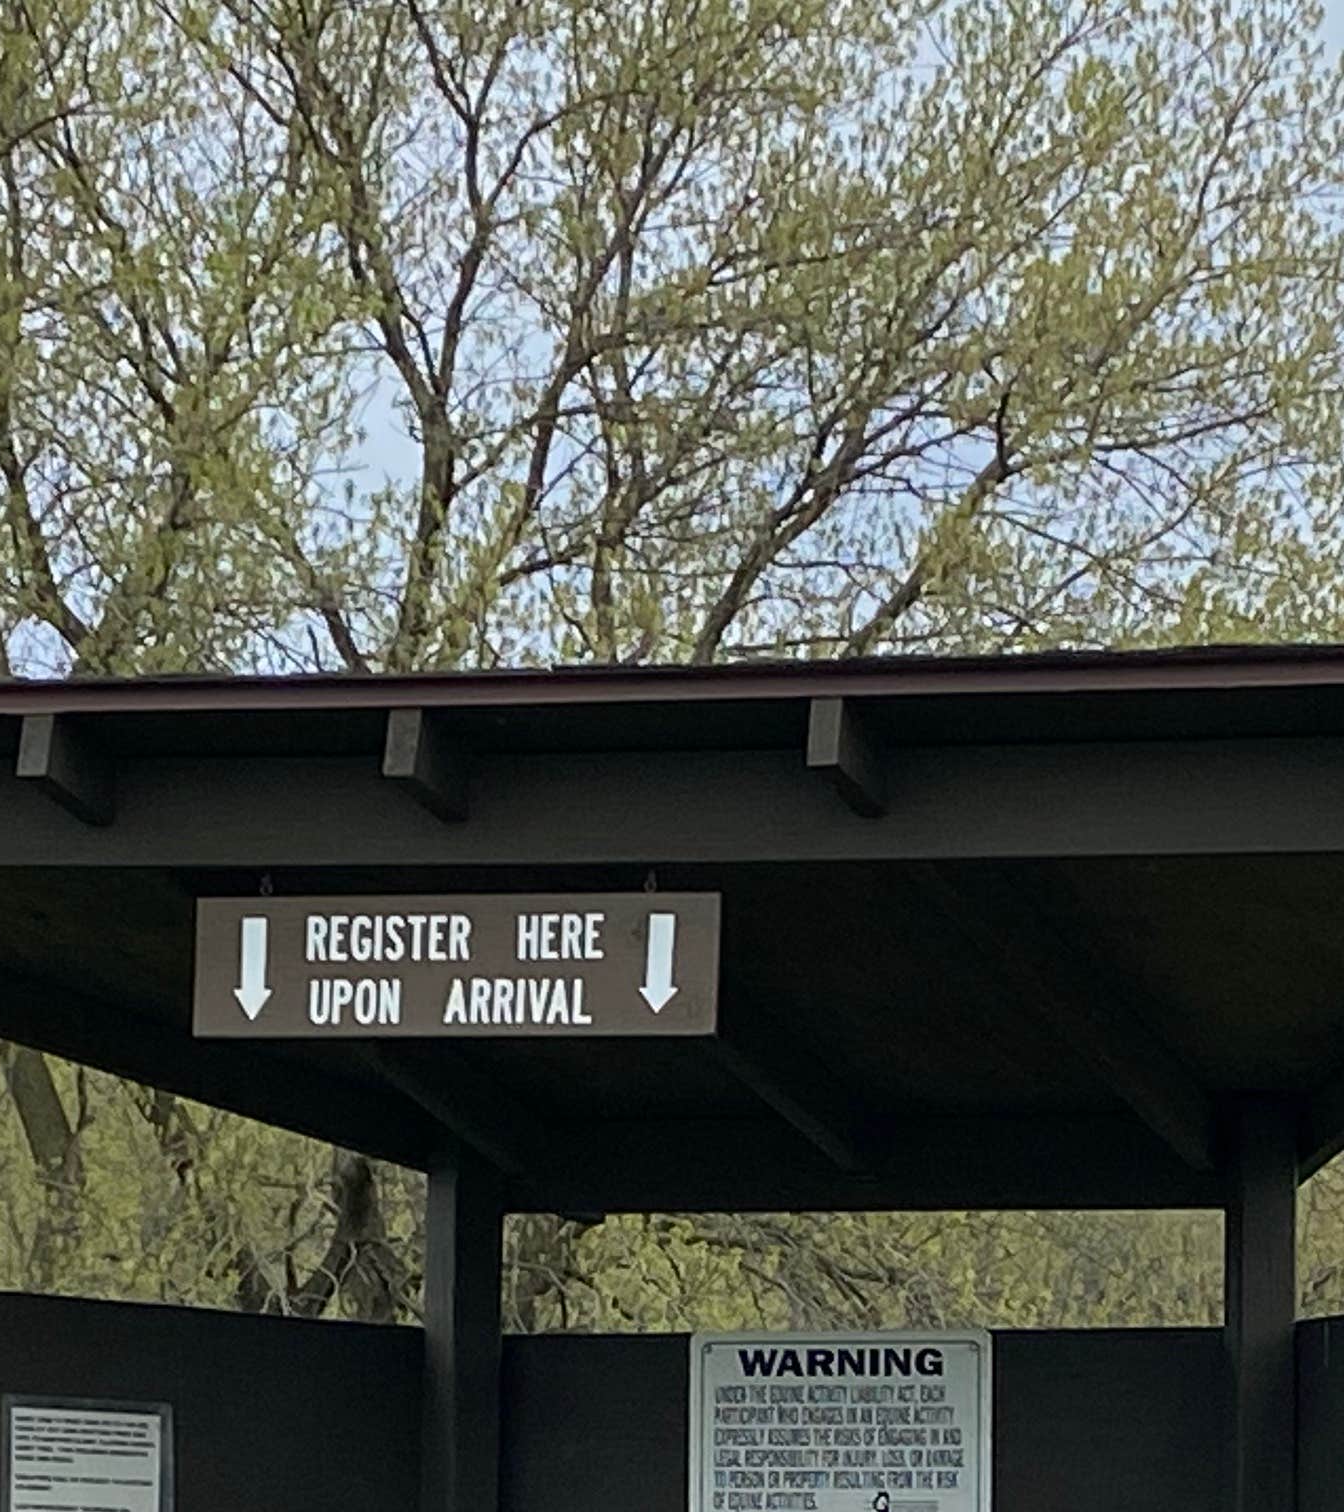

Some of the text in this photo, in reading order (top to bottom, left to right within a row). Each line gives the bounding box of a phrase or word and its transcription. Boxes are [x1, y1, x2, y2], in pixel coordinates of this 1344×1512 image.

[306, 912, 606, 962] REGISTER HERE
[309, 977, 593, 1025] UPON ARRIVAL
[738, 1348, 944, 1377] WARNING
